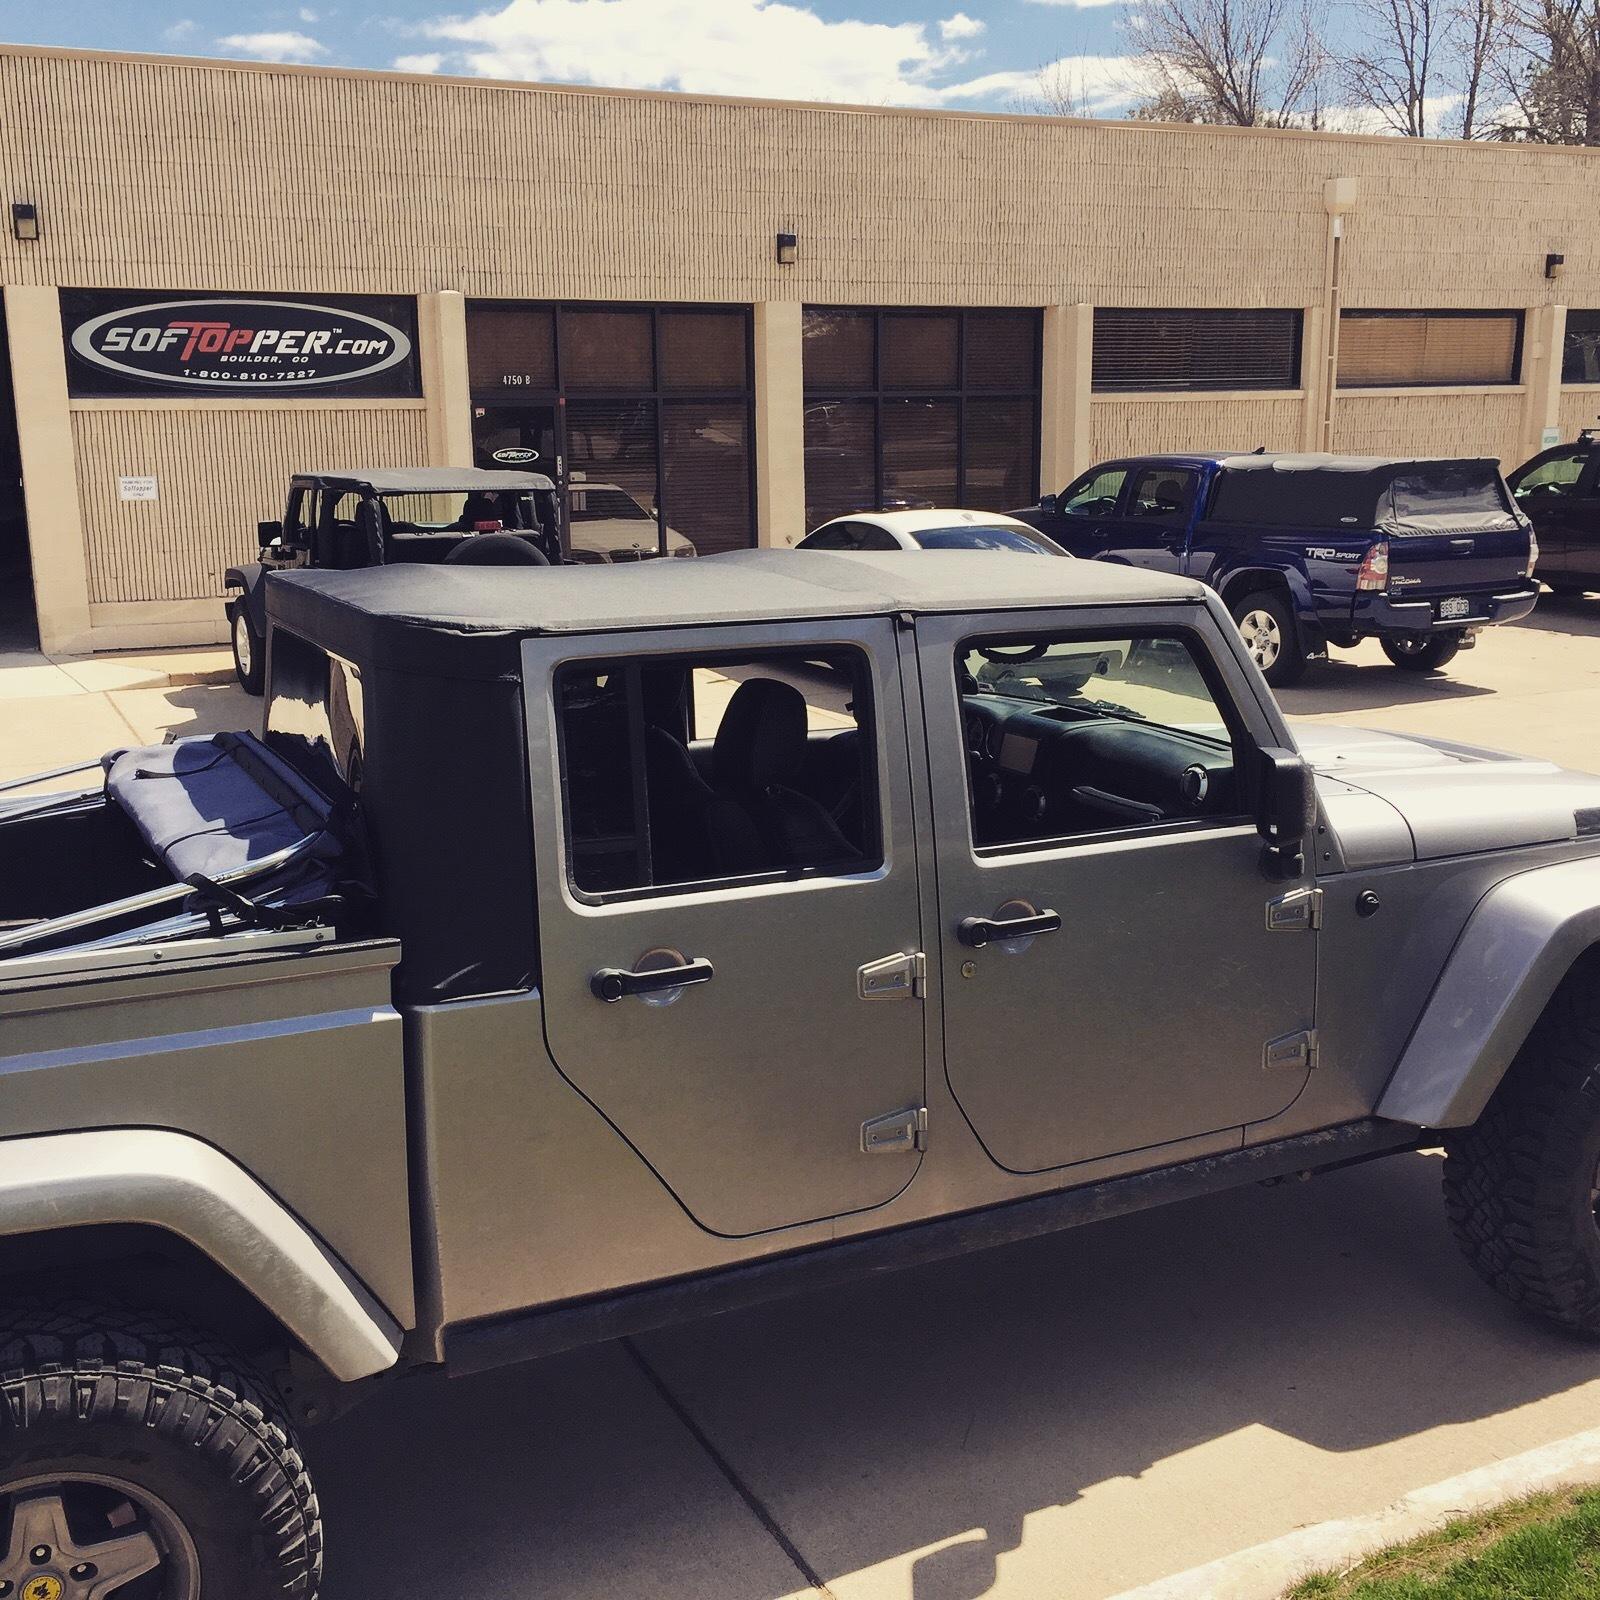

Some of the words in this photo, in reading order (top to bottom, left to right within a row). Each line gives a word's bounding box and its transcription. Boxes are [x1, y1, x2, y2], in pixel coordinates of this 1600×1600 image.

[183, 368, 316, 381] 1-800-810-7227
[502, 375, 522, 385] 4750
[525, 375, 531, 385] B
[1305, 547, 1335, 559] TRD
